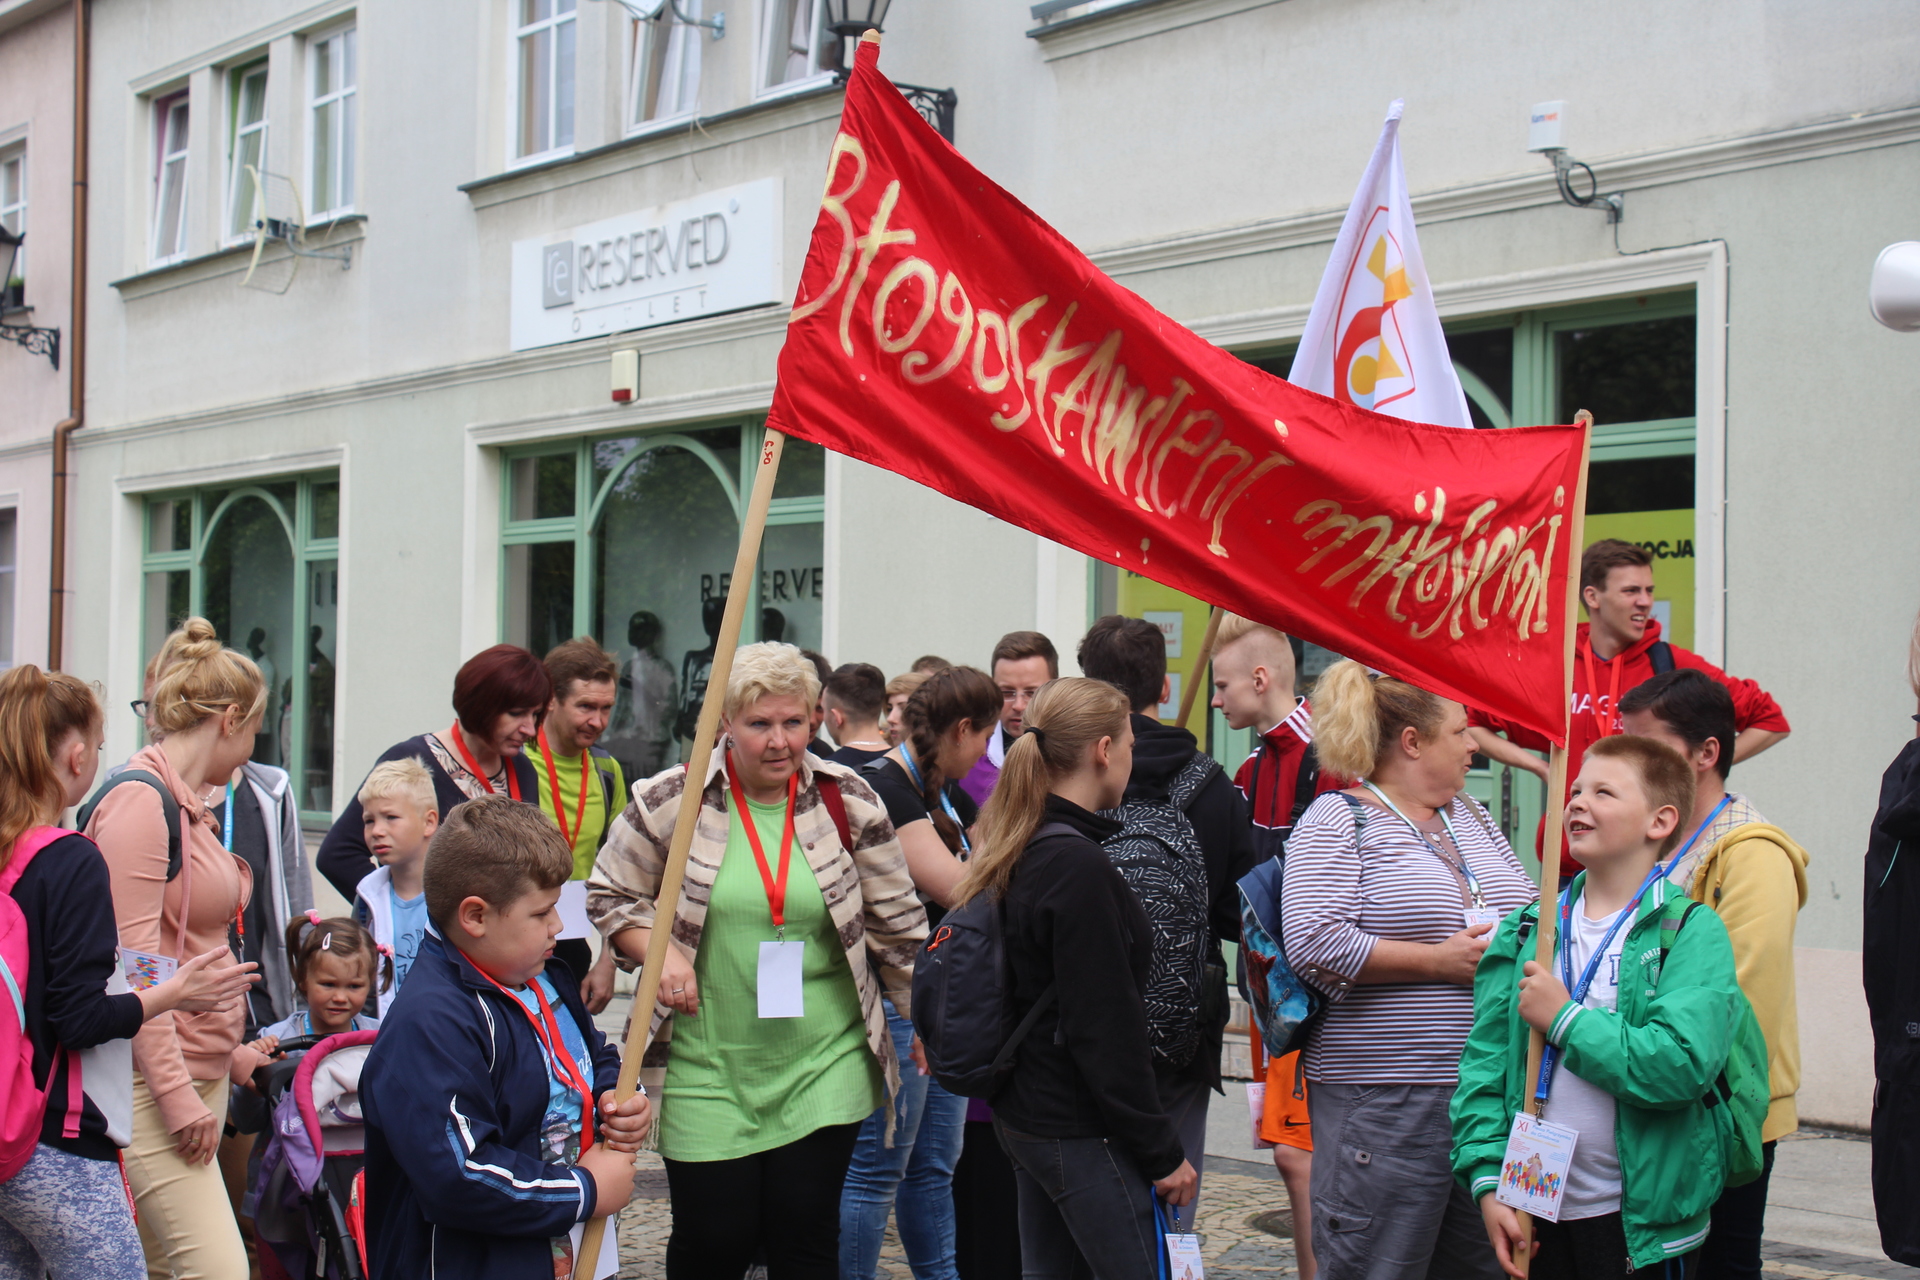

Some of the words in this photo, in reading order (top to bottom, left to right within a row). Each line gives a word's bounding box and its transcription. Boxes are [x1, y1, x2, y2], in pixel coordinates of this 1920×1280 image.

[578, 212, 731, 294] RESERVED
[1634, 539, 1695, 559] OCJA
[701, 567, 824, 601] REERVE
[1517, 1120, 1529, 1132] XI
